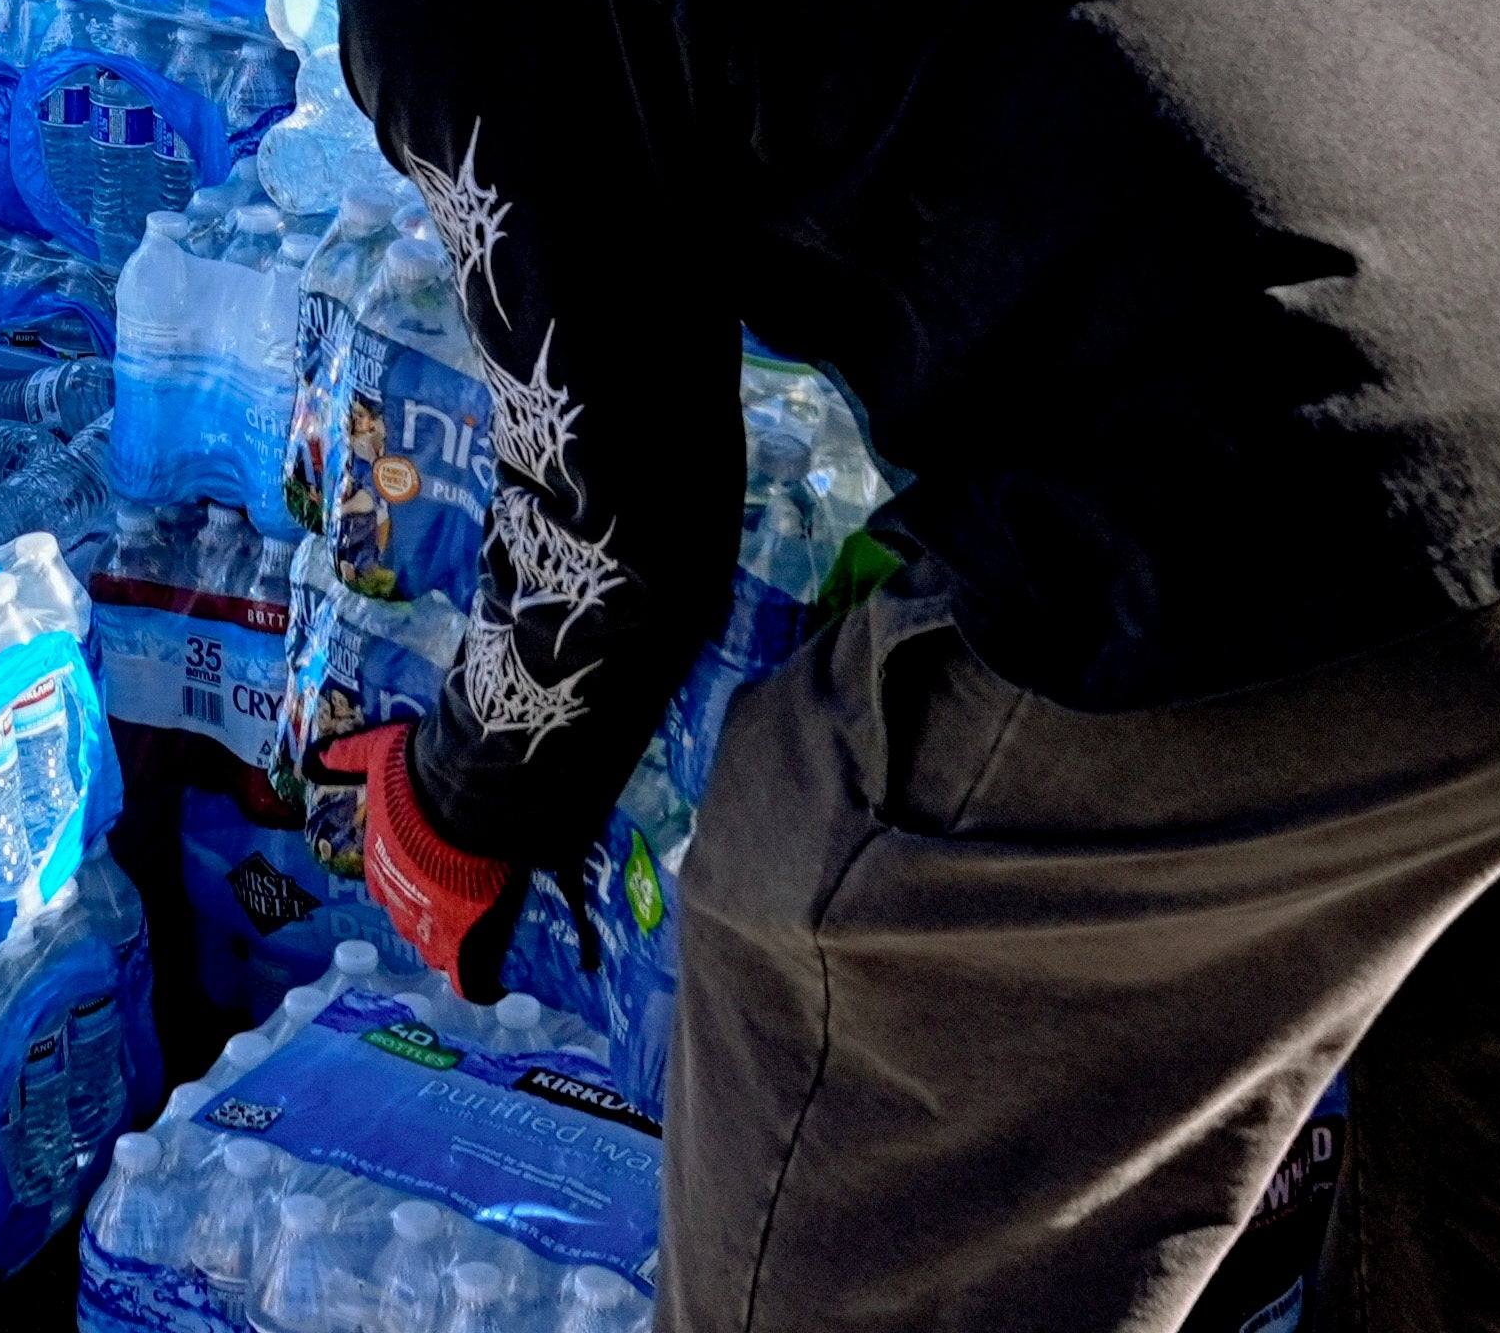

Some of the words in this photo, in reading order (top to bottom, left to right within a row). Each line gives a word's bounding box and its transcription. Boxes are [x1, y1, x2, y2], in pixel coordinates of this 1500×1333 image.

[184, 638, 222, 670] 35
[369, 1032, 455, 1069] BOTTLES
[419, 1079, 587, 1147] purified
